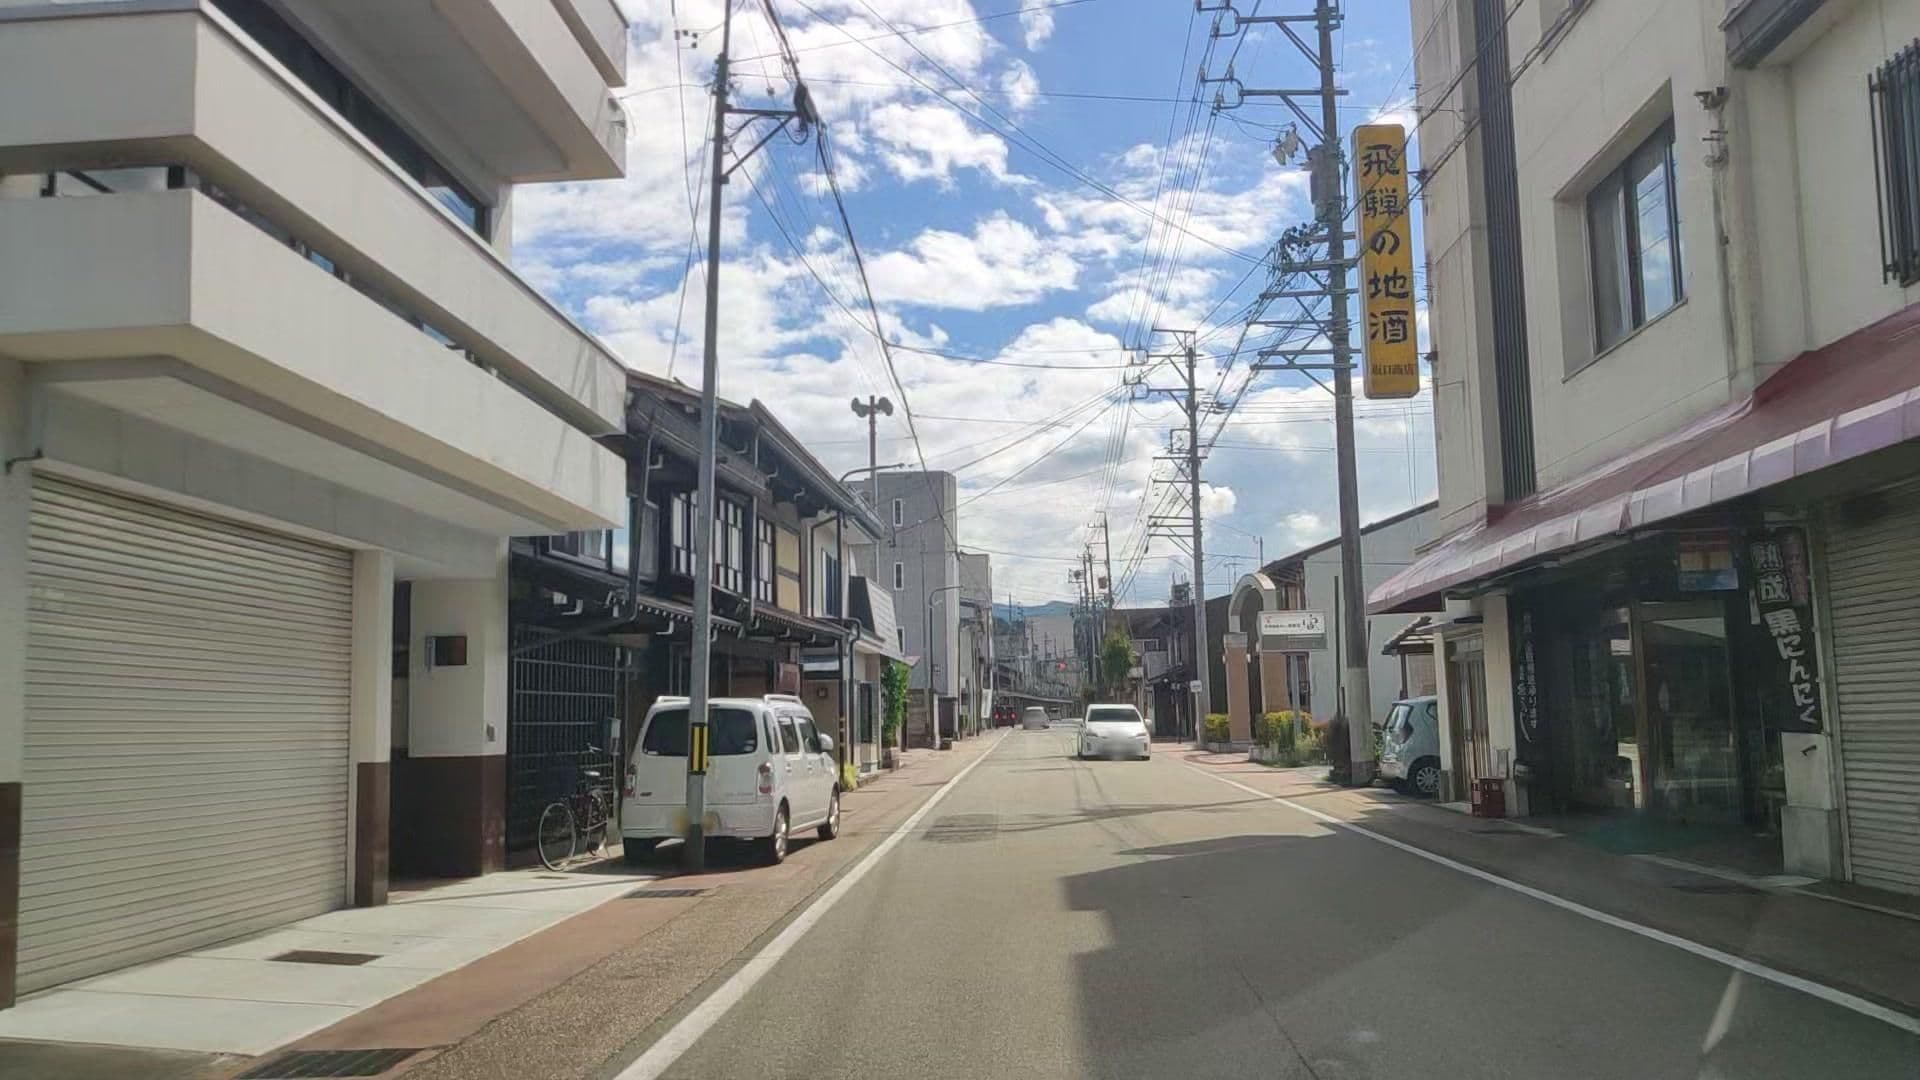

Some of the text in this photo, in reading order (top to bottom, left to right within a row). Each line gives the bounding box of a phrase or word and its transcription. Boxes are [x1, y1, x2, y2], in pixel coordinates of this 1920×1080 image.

[1361, 143, 1410, 345] 飛騨の地酒
[1750, 542, 1792, 603] 熟成
[1763, 608, 1818, 725] 黒にんにく
